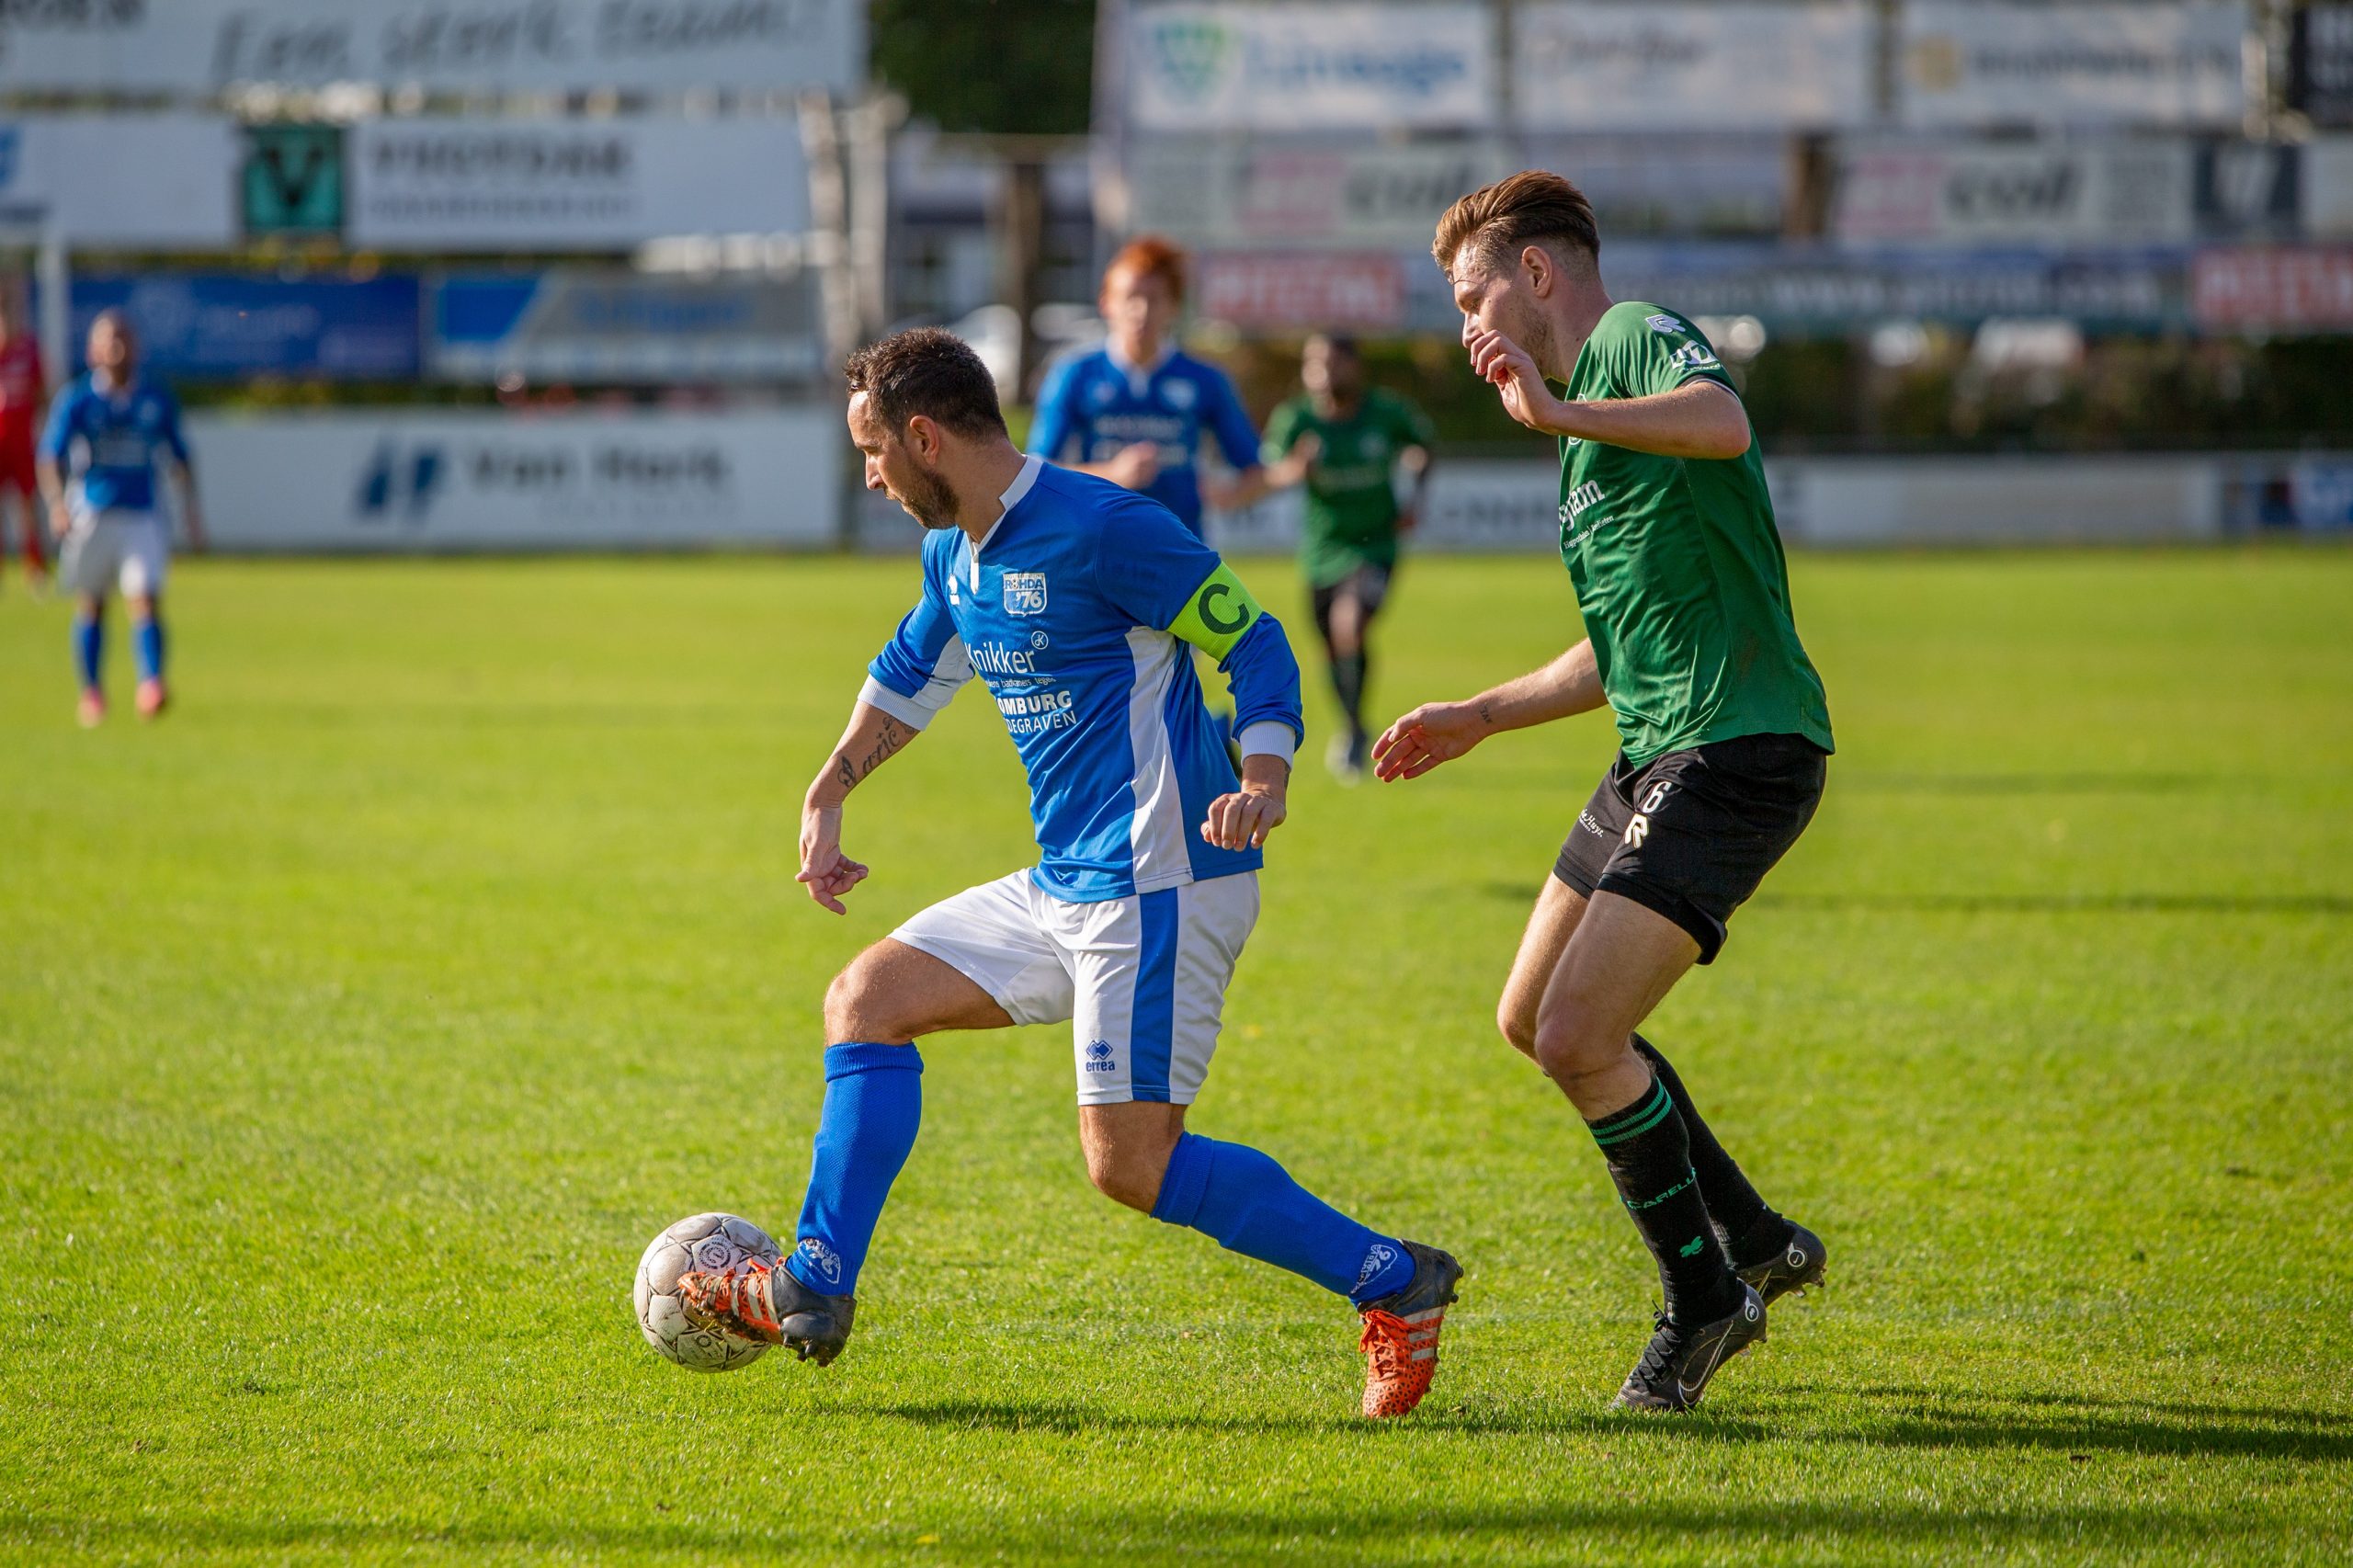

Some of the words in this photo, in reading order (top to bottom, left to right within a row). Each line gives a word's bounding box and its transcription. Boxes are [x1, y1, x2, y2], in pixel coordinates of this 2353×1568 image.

[1198, 583, 1250, 635] C
[964, 641, 1035, 674] Knikker
[996, 690, 1072, 715] OMBURG
[1005, 710, 1076, 733] DEGRAVEN
[1643, 781, 1672, 813] 6
